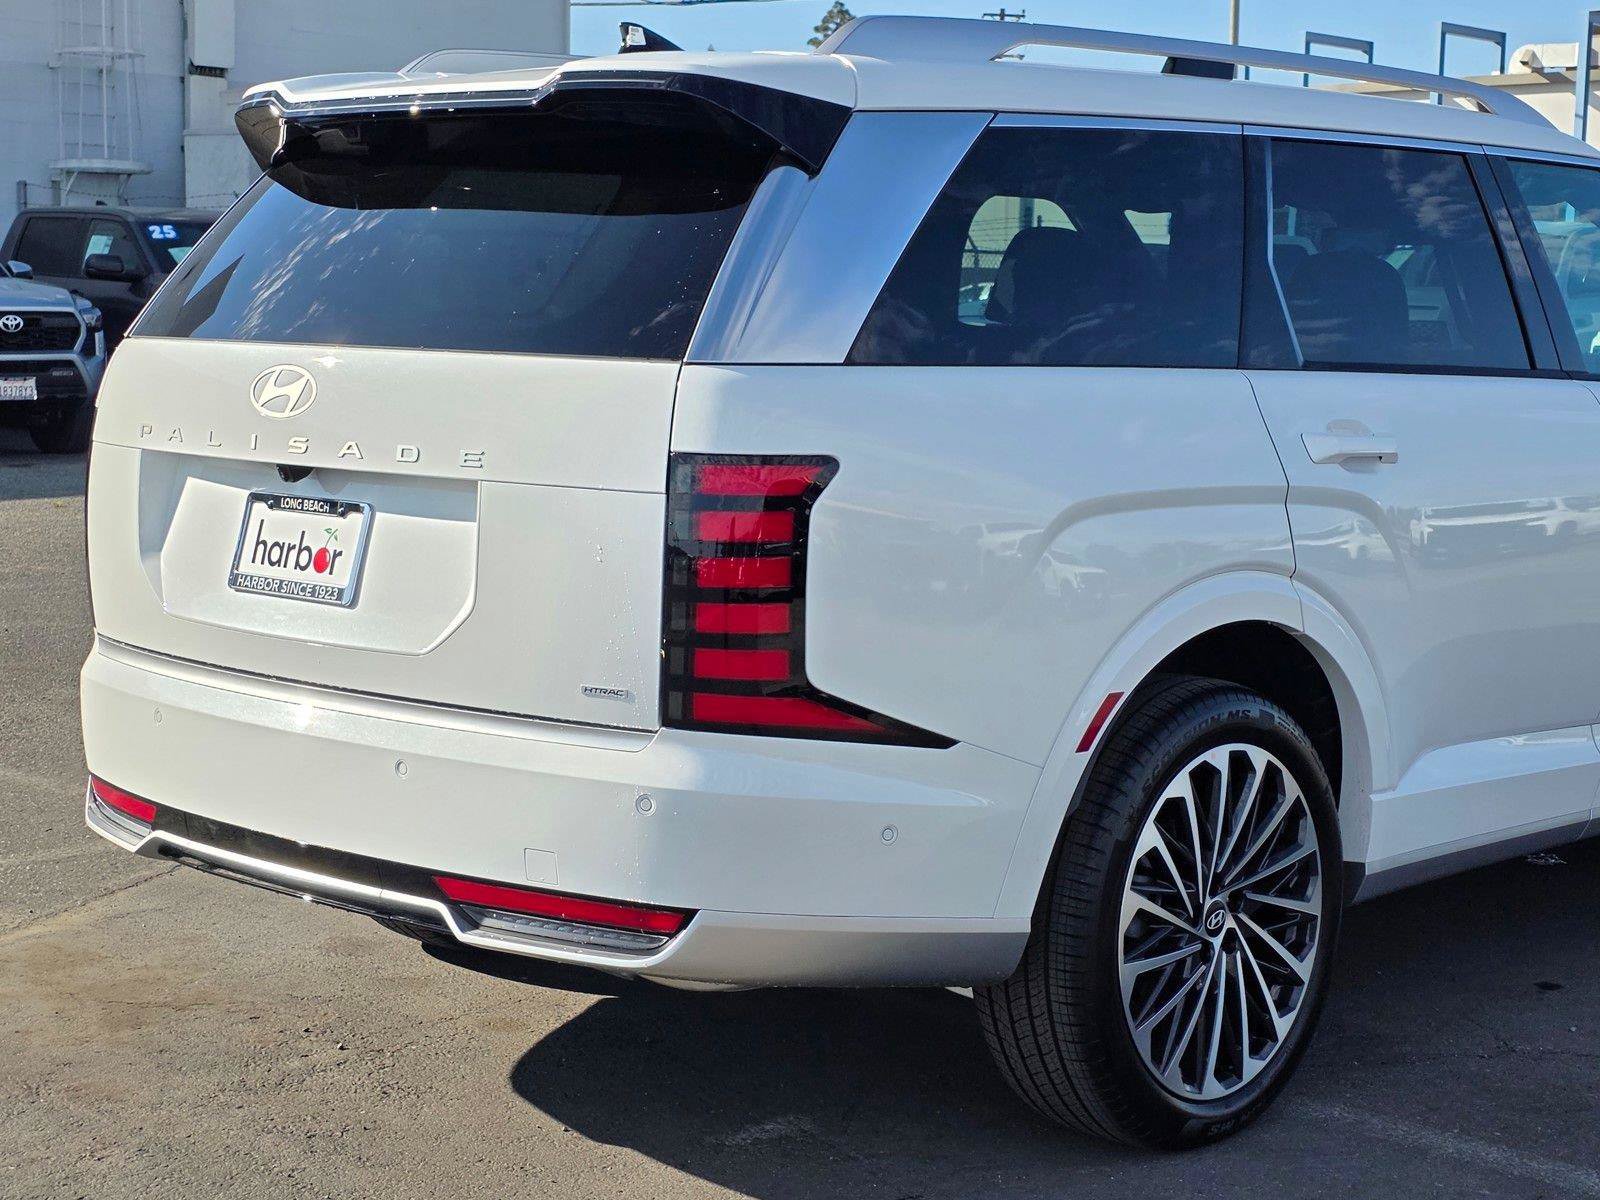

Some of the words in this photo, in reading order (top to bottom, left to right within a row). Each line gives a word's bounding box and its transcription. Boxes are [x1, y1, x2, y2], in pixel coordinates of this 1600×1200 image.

[148, 224, 177, 239] 25
[139, 424, 486, 469] PALISADE
[280, 497, 302, 510] LONG
[303, 499, 330, 513] BEACH
[251, 519, 343, 575] harbor
[236, 575, 280, 592] HARBOR
[281, 580, 313, 597] SINCE
[315, 582, 339, 600] 1923
[583, 686, 625, 697] HTRAC
